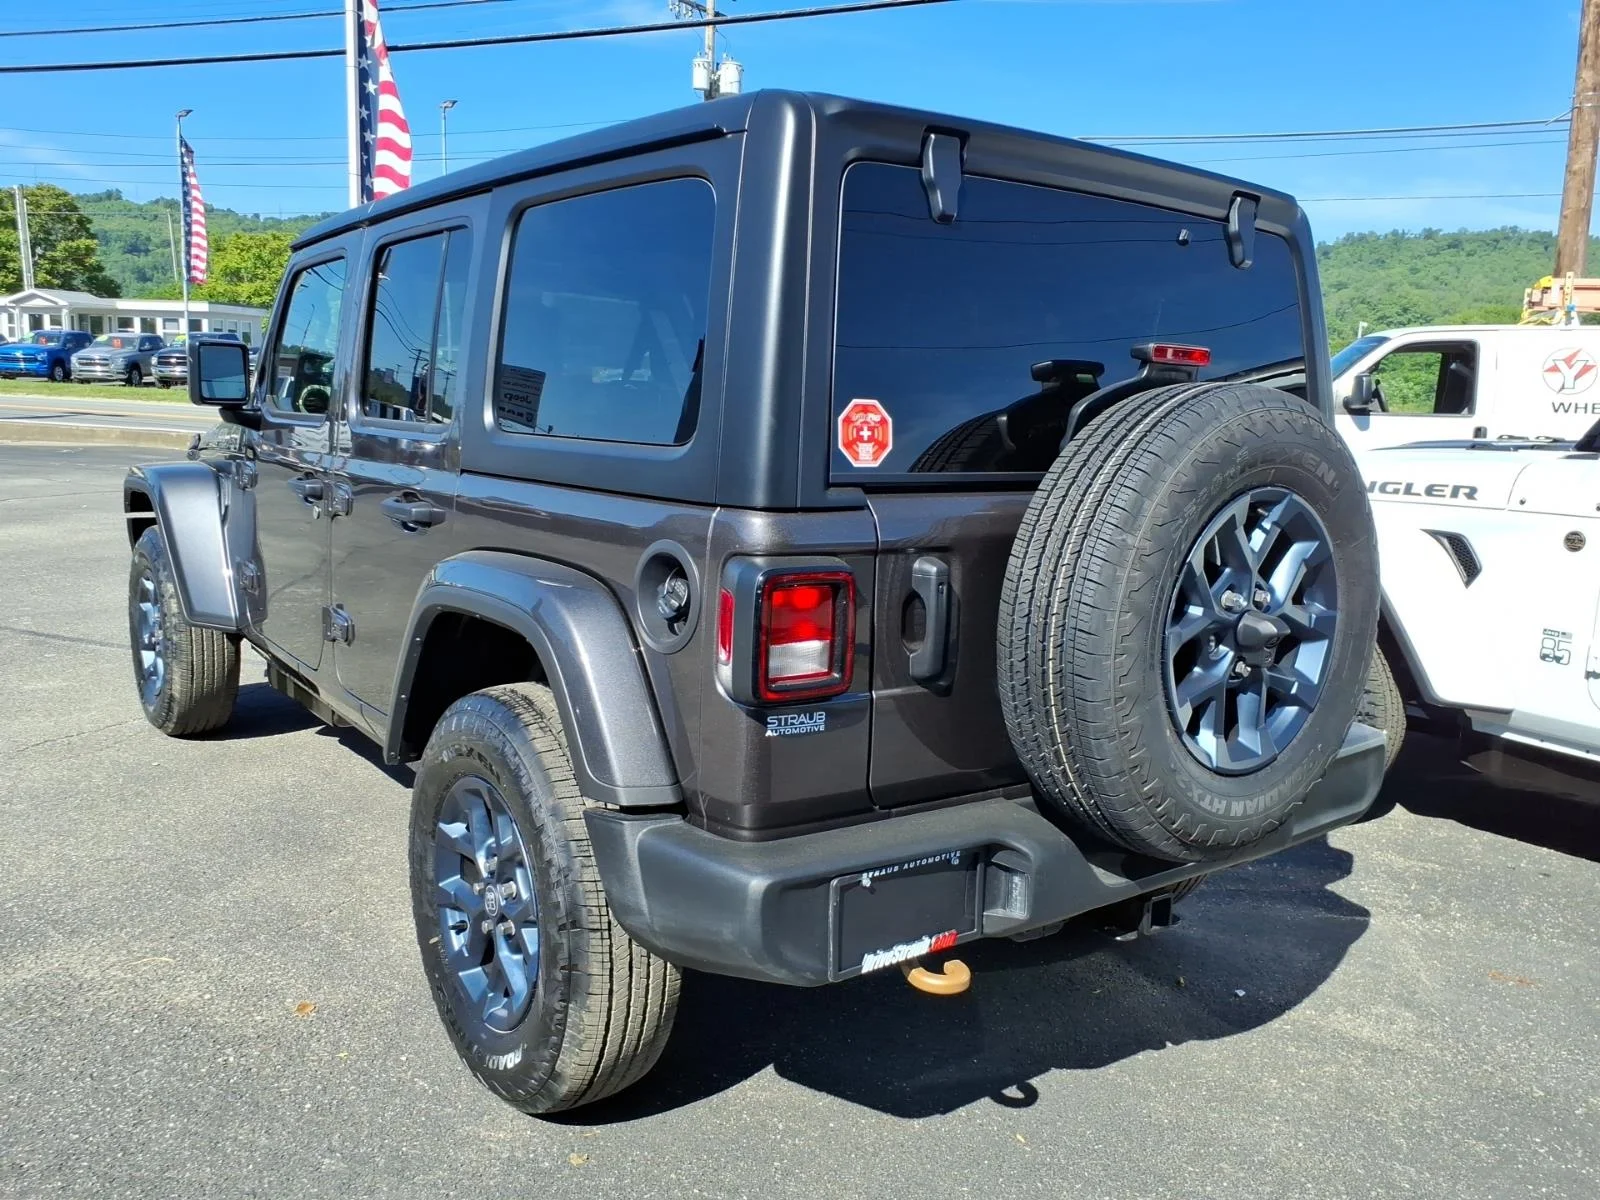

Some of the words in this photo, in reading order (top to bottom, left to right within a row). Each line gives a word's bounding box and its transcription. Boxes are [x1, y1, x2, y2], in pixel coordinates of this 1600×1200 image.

[1540, 637, 1572, 665] 85
[767, 711, 826, 727] STRAUB
[765, 724, 825, 737] AUTOMOTIVE
[903, 850, 961, 870] AUTOMOTIVE
